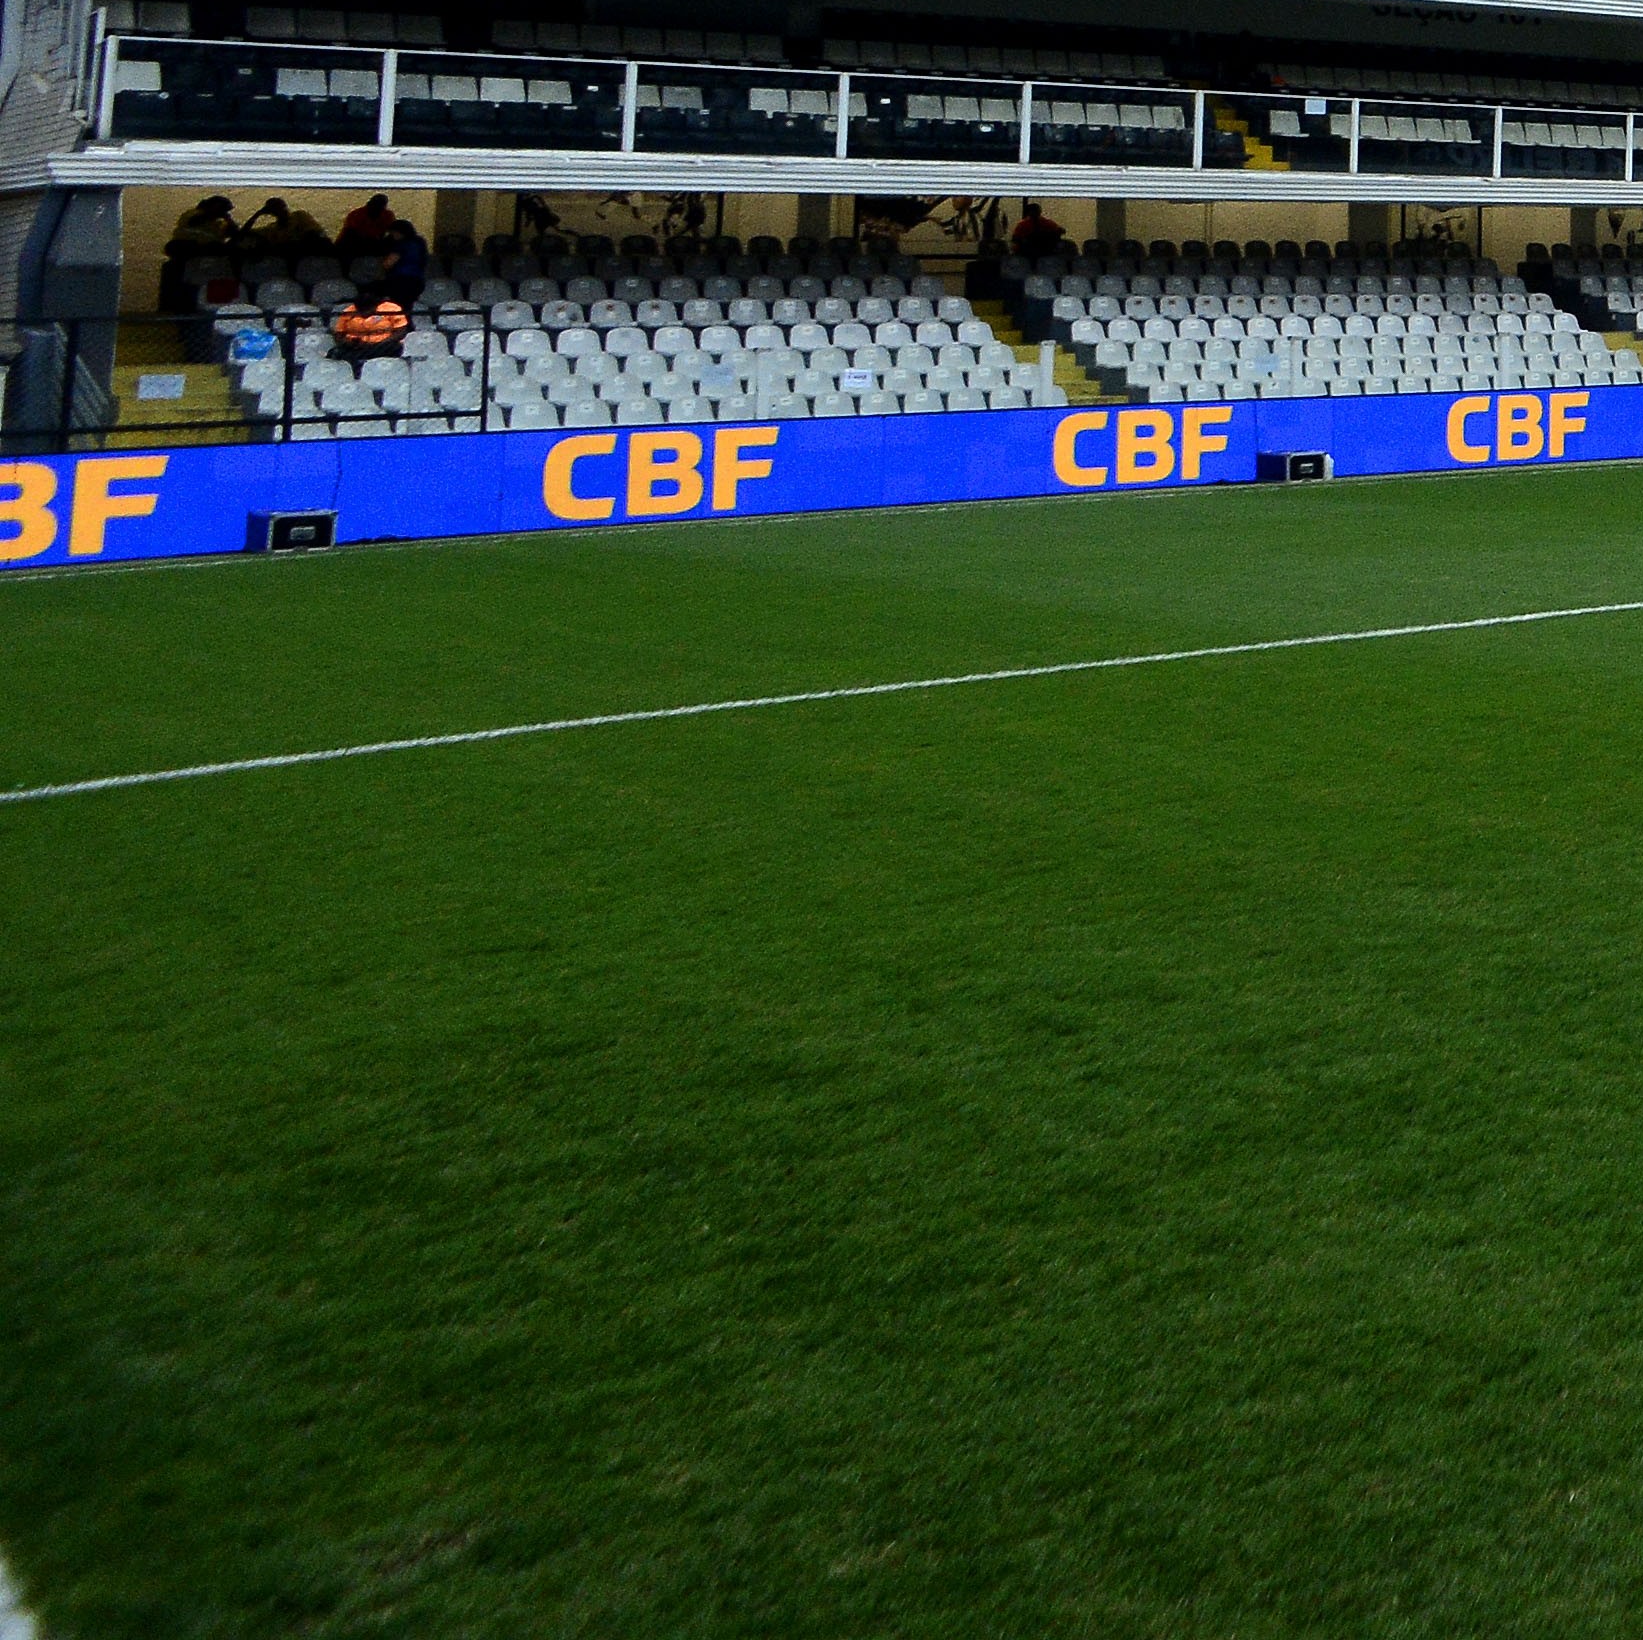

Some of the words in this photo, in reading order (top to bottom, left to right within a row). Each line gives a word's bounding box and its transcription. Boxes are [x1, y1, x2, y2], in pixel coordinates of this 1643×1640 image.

[1053, 406, 1233, 487] CBF
[1446, 391, 1590, 463] CBF
[543, 426, 780, 521] CBF
